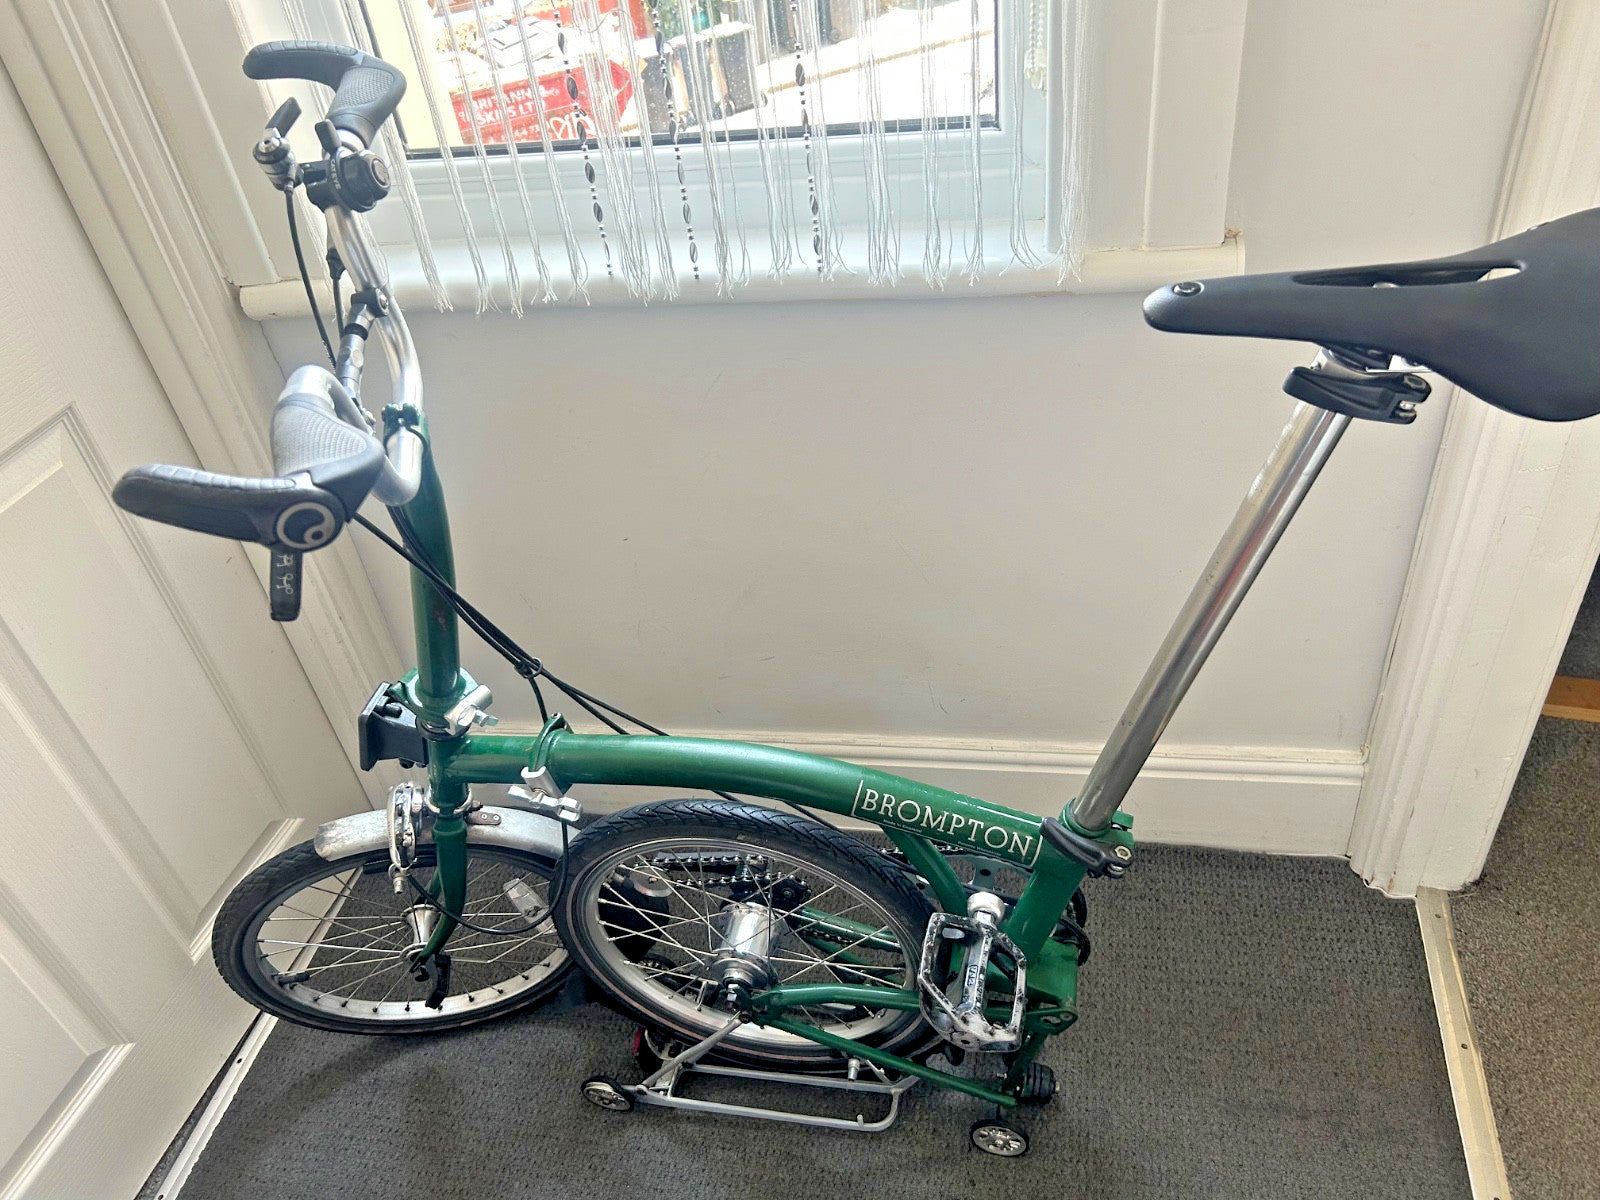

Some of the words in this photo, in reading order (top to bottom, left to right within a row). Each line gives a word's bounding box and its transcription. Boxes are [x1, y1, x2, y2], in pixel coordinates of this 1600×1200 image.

[471, 84, 548, 111] BRIANNA
[477, 105, 517, 126] SKIS
[861, 788, 1033, 861] BROMPTON
